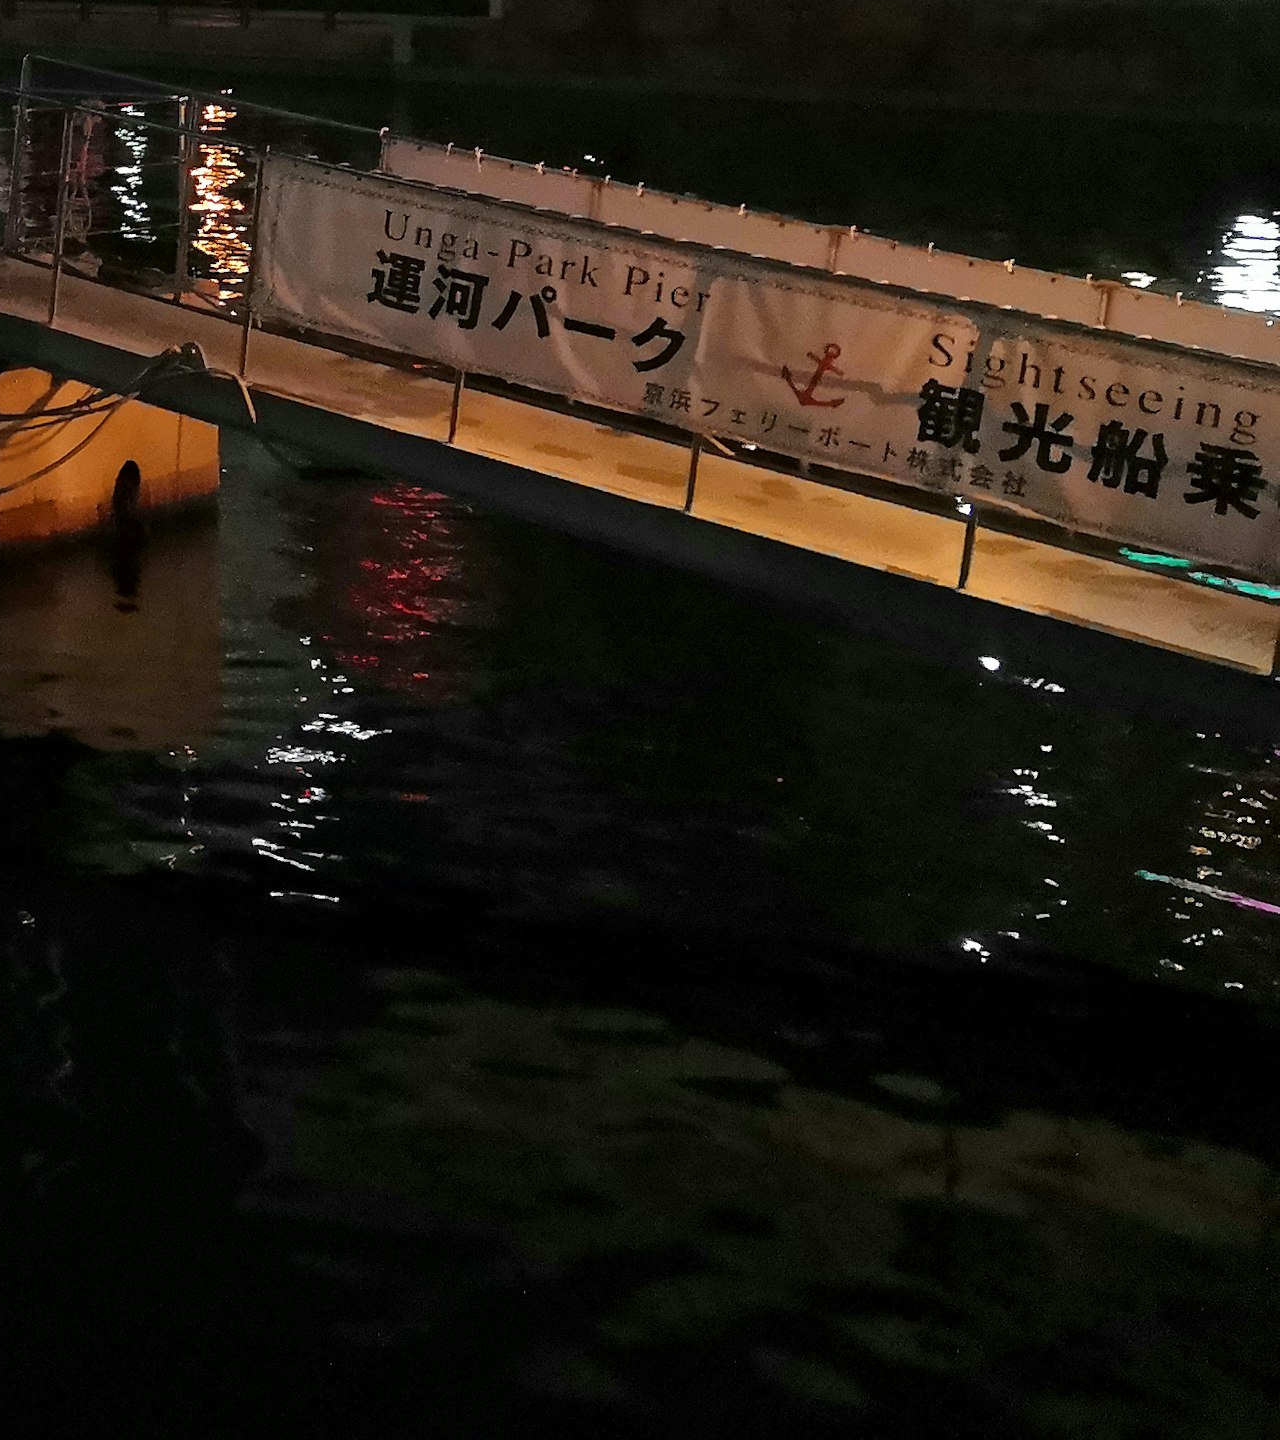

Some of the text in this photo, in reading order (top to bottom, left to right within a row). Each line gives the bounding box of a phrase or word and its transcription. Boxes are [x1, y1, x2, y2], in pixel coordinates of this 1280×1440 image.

[368, 250, 685, 372] 運河パーク
[386, 210, 711, 312] Unga-Park Pier
[929, 334, 1262, 445] Sightseeing
[918, 378, 1269, 520] 観光船乗
